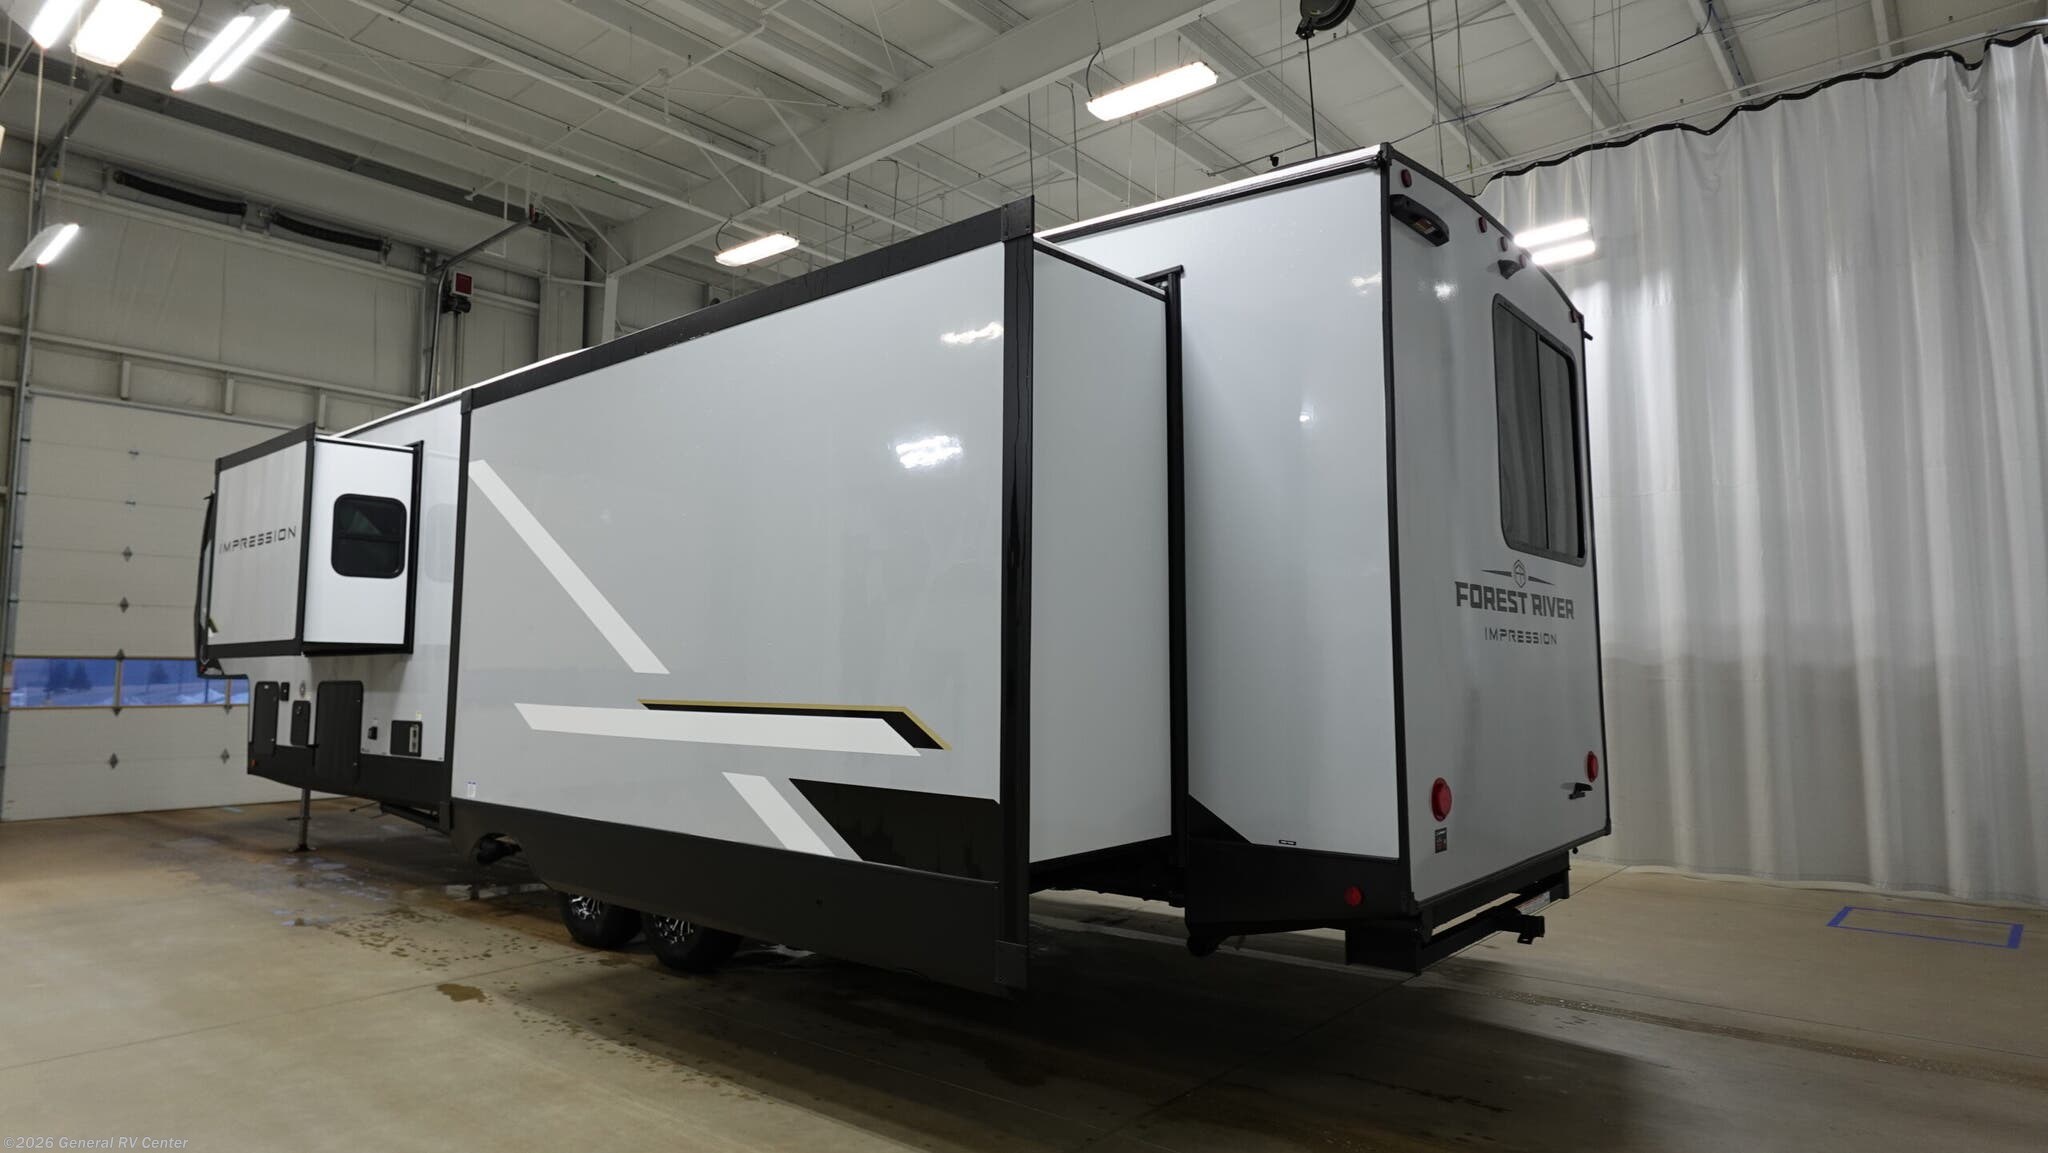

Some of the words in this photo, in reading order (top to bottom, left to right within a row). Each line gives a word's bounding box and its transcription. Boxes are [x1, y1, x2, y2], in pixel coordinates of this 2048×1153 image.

[219, 525, 296, 554] IMPRESSION
[1454, 581, 1527, 614] FOREST
[1530, 593, 1575, 619] RIVER
[1484, 626, 1557, 645] IMPRESSION
